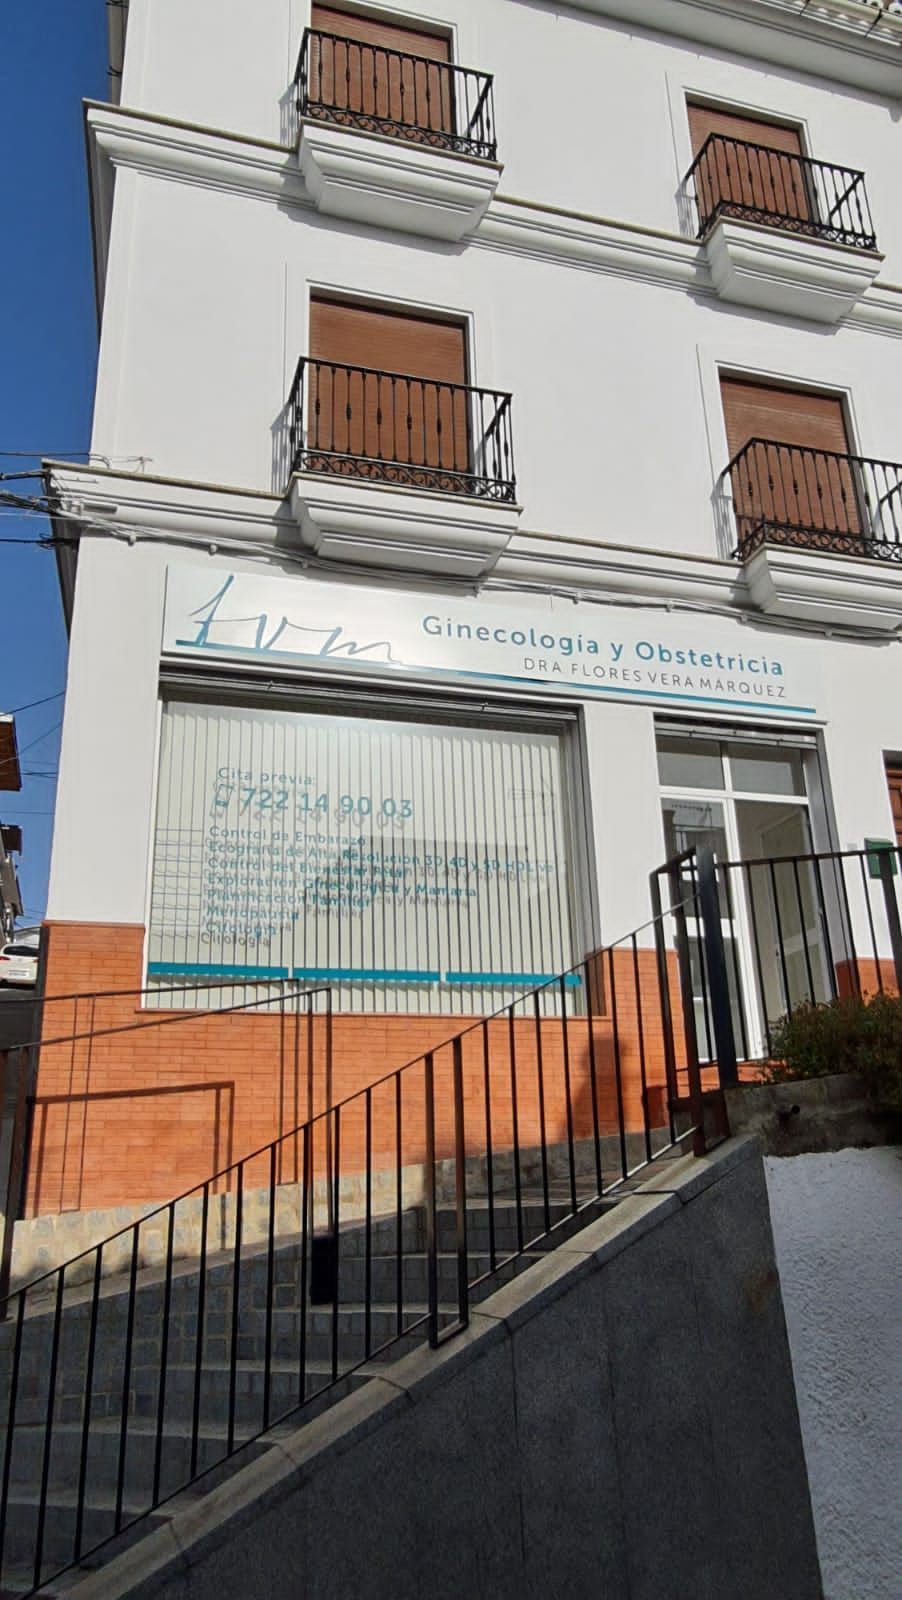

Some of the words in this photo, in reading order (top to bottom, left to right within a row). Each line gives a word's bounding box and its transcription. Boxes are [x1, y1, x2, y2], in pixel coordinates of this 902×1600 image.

[610, 642, 623, 661] y
[635, 641, 783, 676] Obstetricia
[524, 657, 562, 673] DRA
[571, 663, 642, 682] FLORES
[647, 671, 695, 689] VERA
[218, 767, 252, 781] Cita
[242, 787, 289, 809] 722
[300, 792, 328, 812] 14
[340, 795, 371, 816] 90
[382, 798, 413, 819] 03
[208, 825, 266, 840] Control
[272, 829, 289, 841] de
[294, 831, 365, 847] Embarazo
[207, 857, 265, 872] Control
